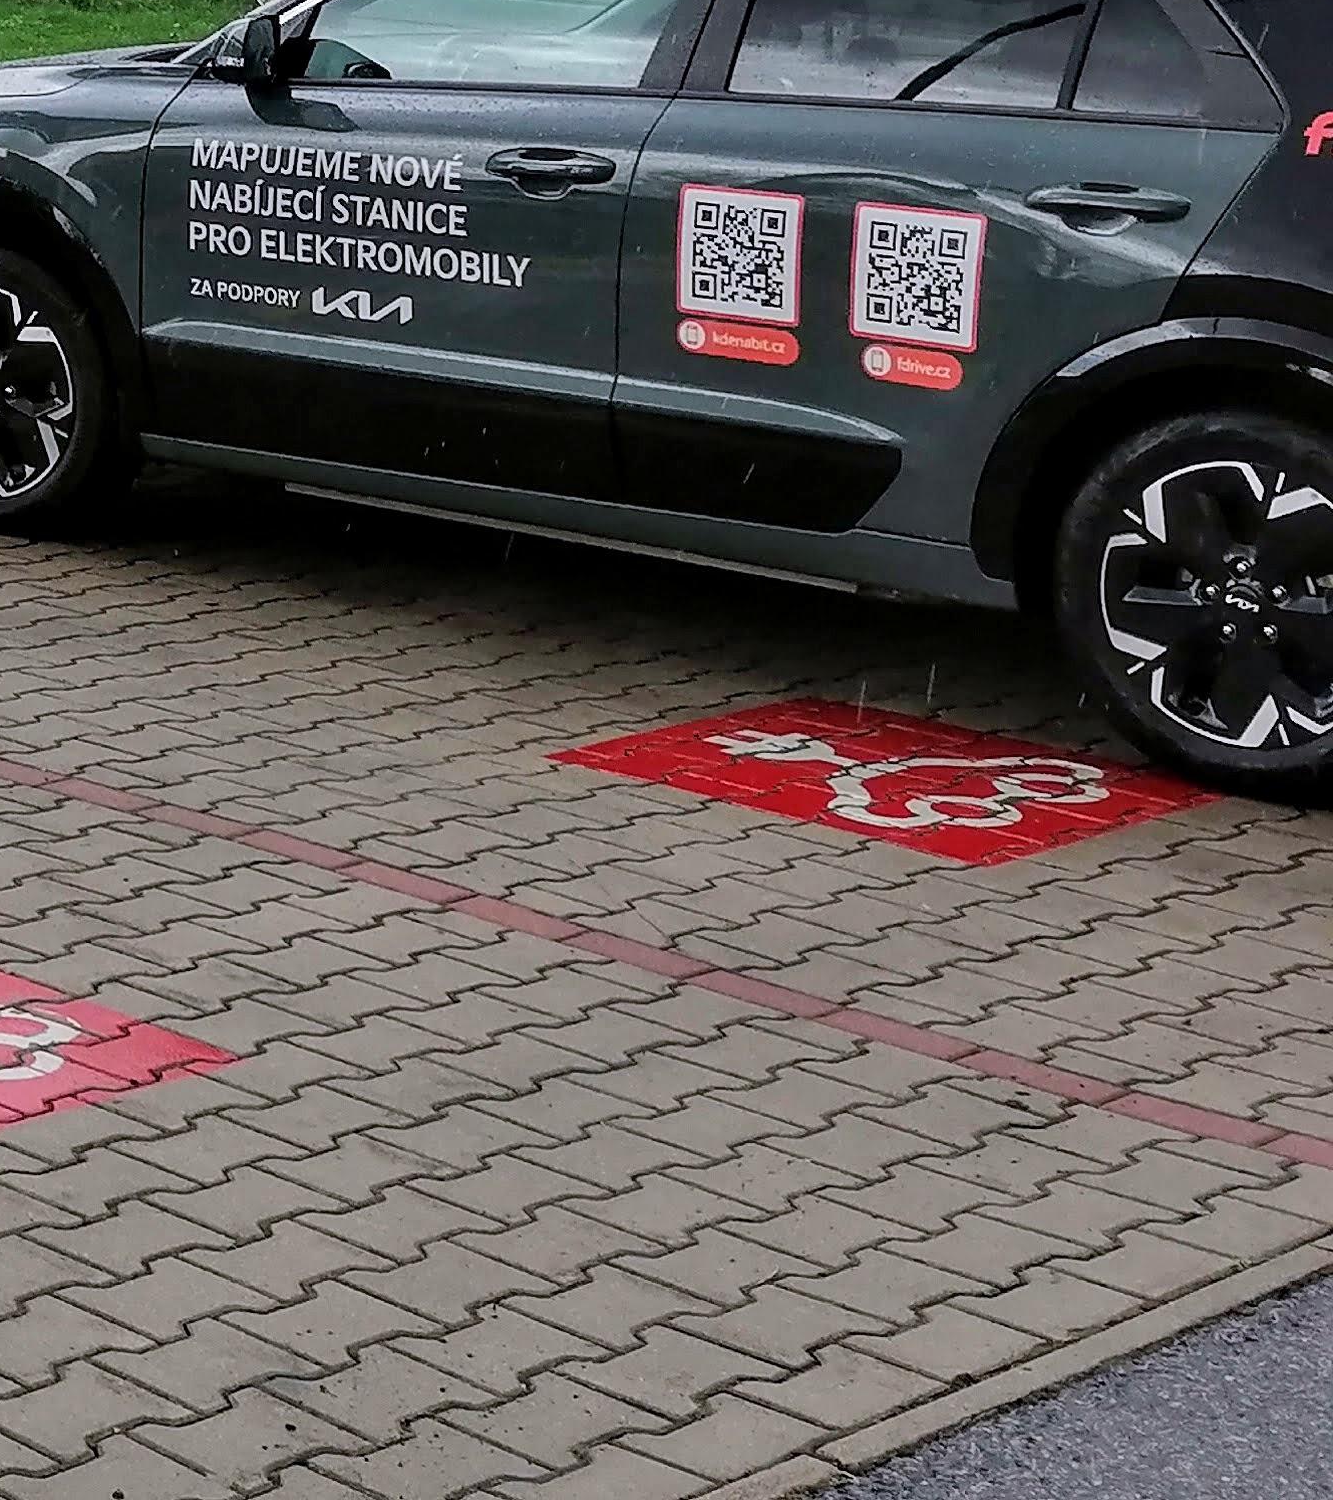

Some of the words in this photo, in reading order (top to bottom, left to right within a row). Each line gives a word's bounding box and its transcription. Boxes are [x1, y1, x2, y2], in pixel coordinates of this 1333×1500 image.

[191, 137, 362, 182] MAPUJEME
[369, 152, 464, 192] NOVÉ
[188, 178, 327, 222] NABÍJECÍ
[331, 193, 469, 238] STANICE
[188, 220, 252, 257] PRO
[260, 229, 532, 288] ELEKTROMOBILY
[190, 277, 213, 299] ZA
[217, 282, 301, 309] PODPORY
[311, 286, 414, 325] KIA
[712, 331, 786, 354] kdenabit.cz
[896, 356, 952, 379] fdrive.cz
